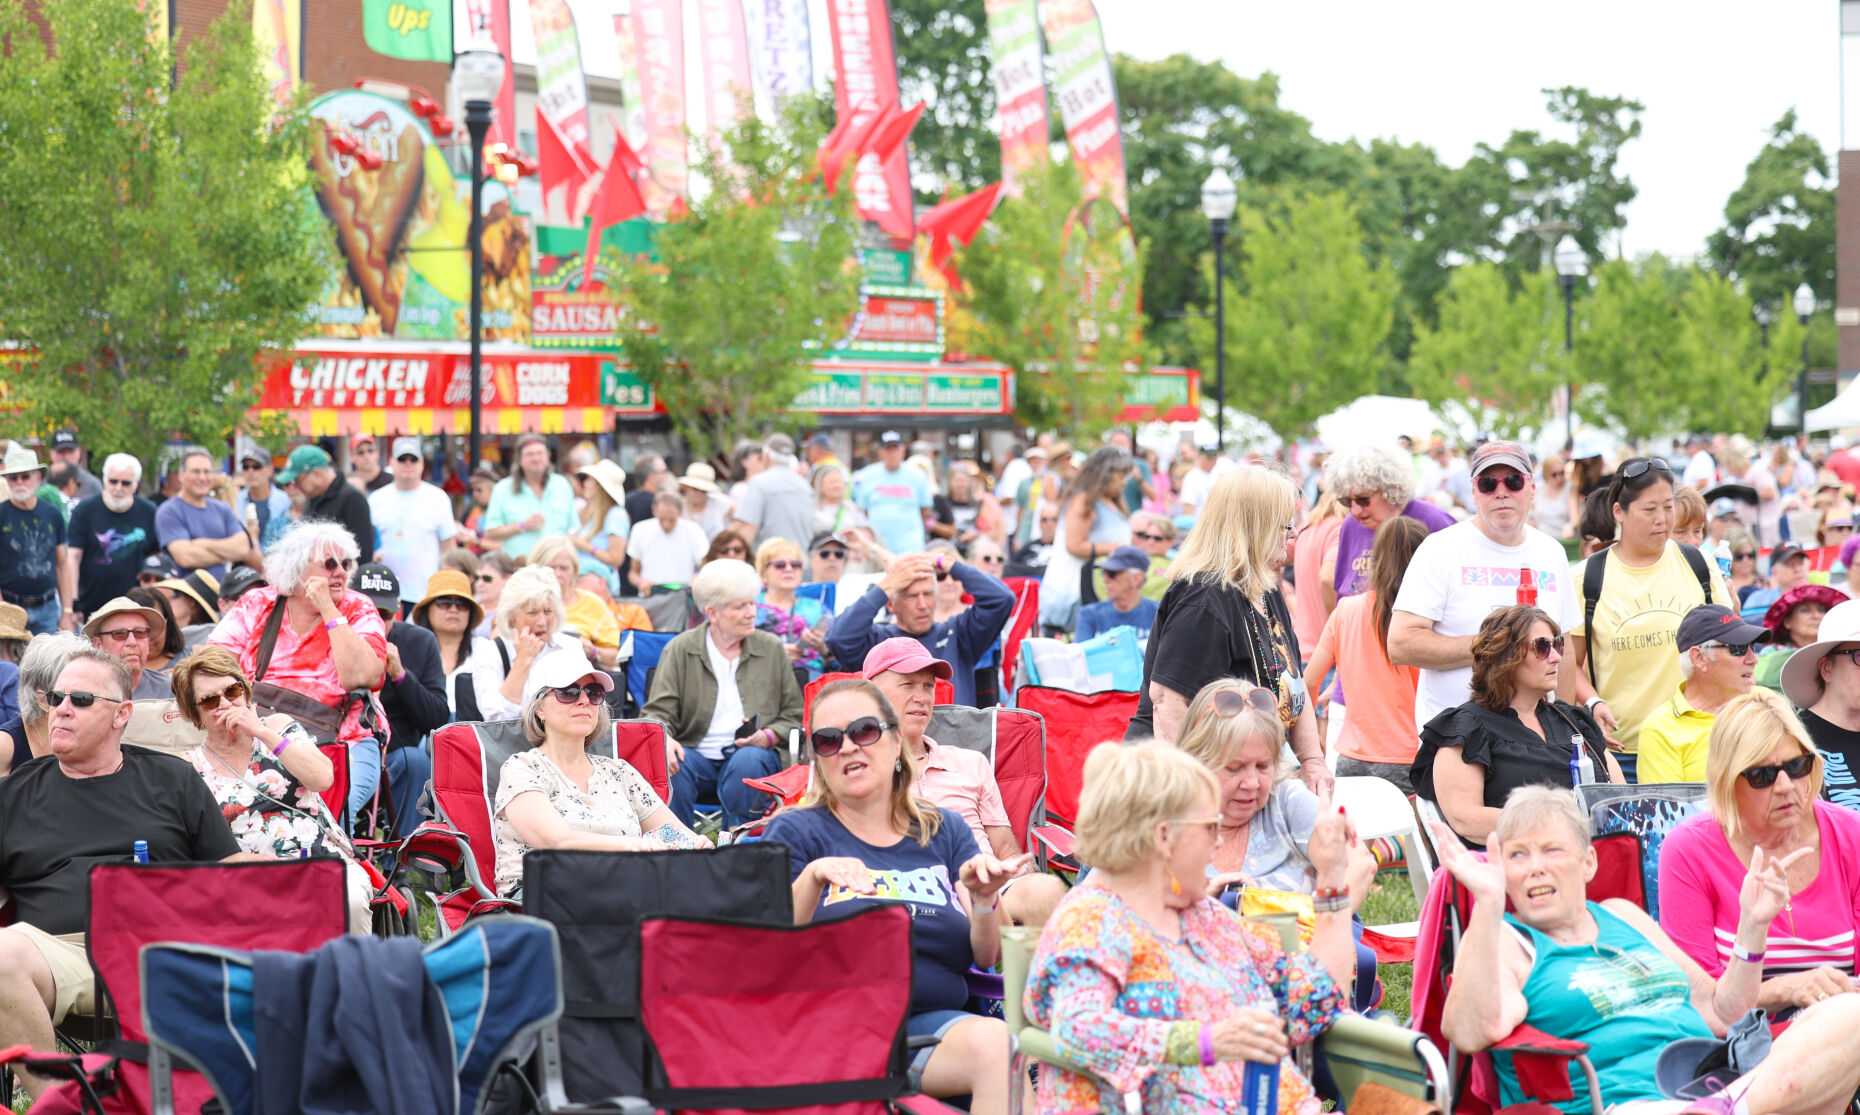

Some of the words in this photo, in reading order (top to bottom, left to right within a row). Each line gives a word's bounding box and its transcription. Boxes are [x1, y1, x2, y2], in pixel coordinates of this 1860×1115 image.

[388, 3, 432, 37] Ups
[533, 305, 636, 331] SAUSA
[290, 357, 429, 390] CHICKEN
[516, 361, 571, 384] CORN
[292, 389, 426, 406] TENDERS
[517, 383, 569, 406] DOGS
[361, 574, 392, 591] BEATLES
[1611, 636, 1632, 652] HERE
[1634, 631, 1663, 649] COMES
[1665, 629, 1677, 645] TH
[1816, 749, 1857, 787] PAUL
